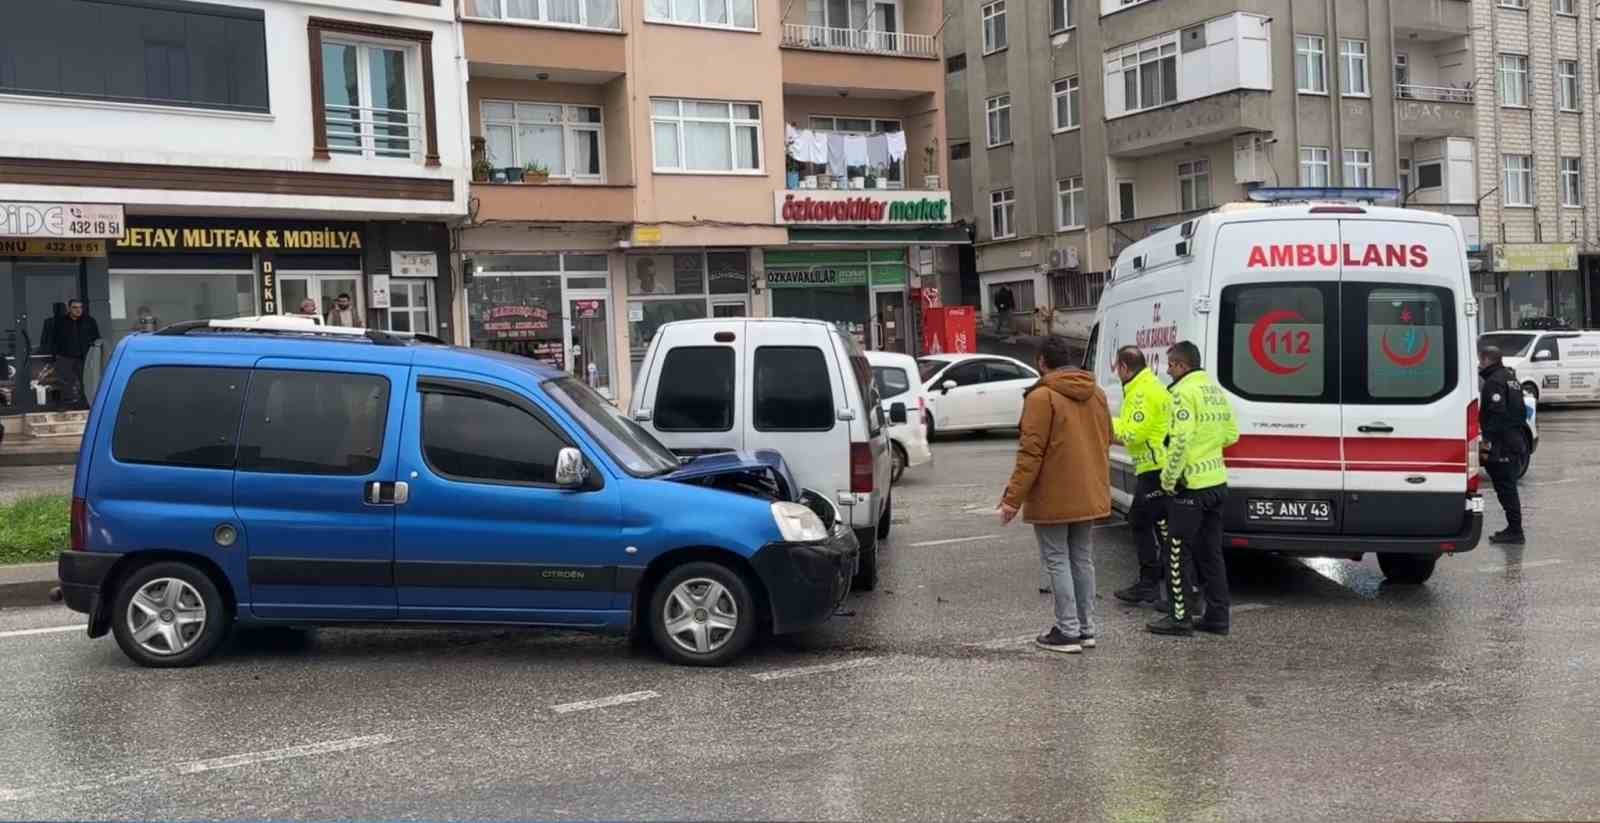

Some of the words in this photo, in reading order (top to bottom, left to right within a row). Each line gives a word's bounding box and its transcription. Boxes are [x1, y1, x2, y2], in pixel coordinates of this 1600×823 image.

[889, 198, 948, 221] market
[69, 220, 91, 235] 432
[93, 220, 106, 235] 19
[108, 220, 120, 235] 51
[182, 229, 263, 249] MUTFAK
[265, 229, 281, 249] &
[283, 226, 362, 249] MOBİLYA
[1247, 243, 1429, 268] AMBULANS
[1265, 329, 1312, 354] 112
[1256, 502, 1275, 516] 55
[1279, 502, 1307, 516] ANY
[1310, 503, 1329, 517] 43
